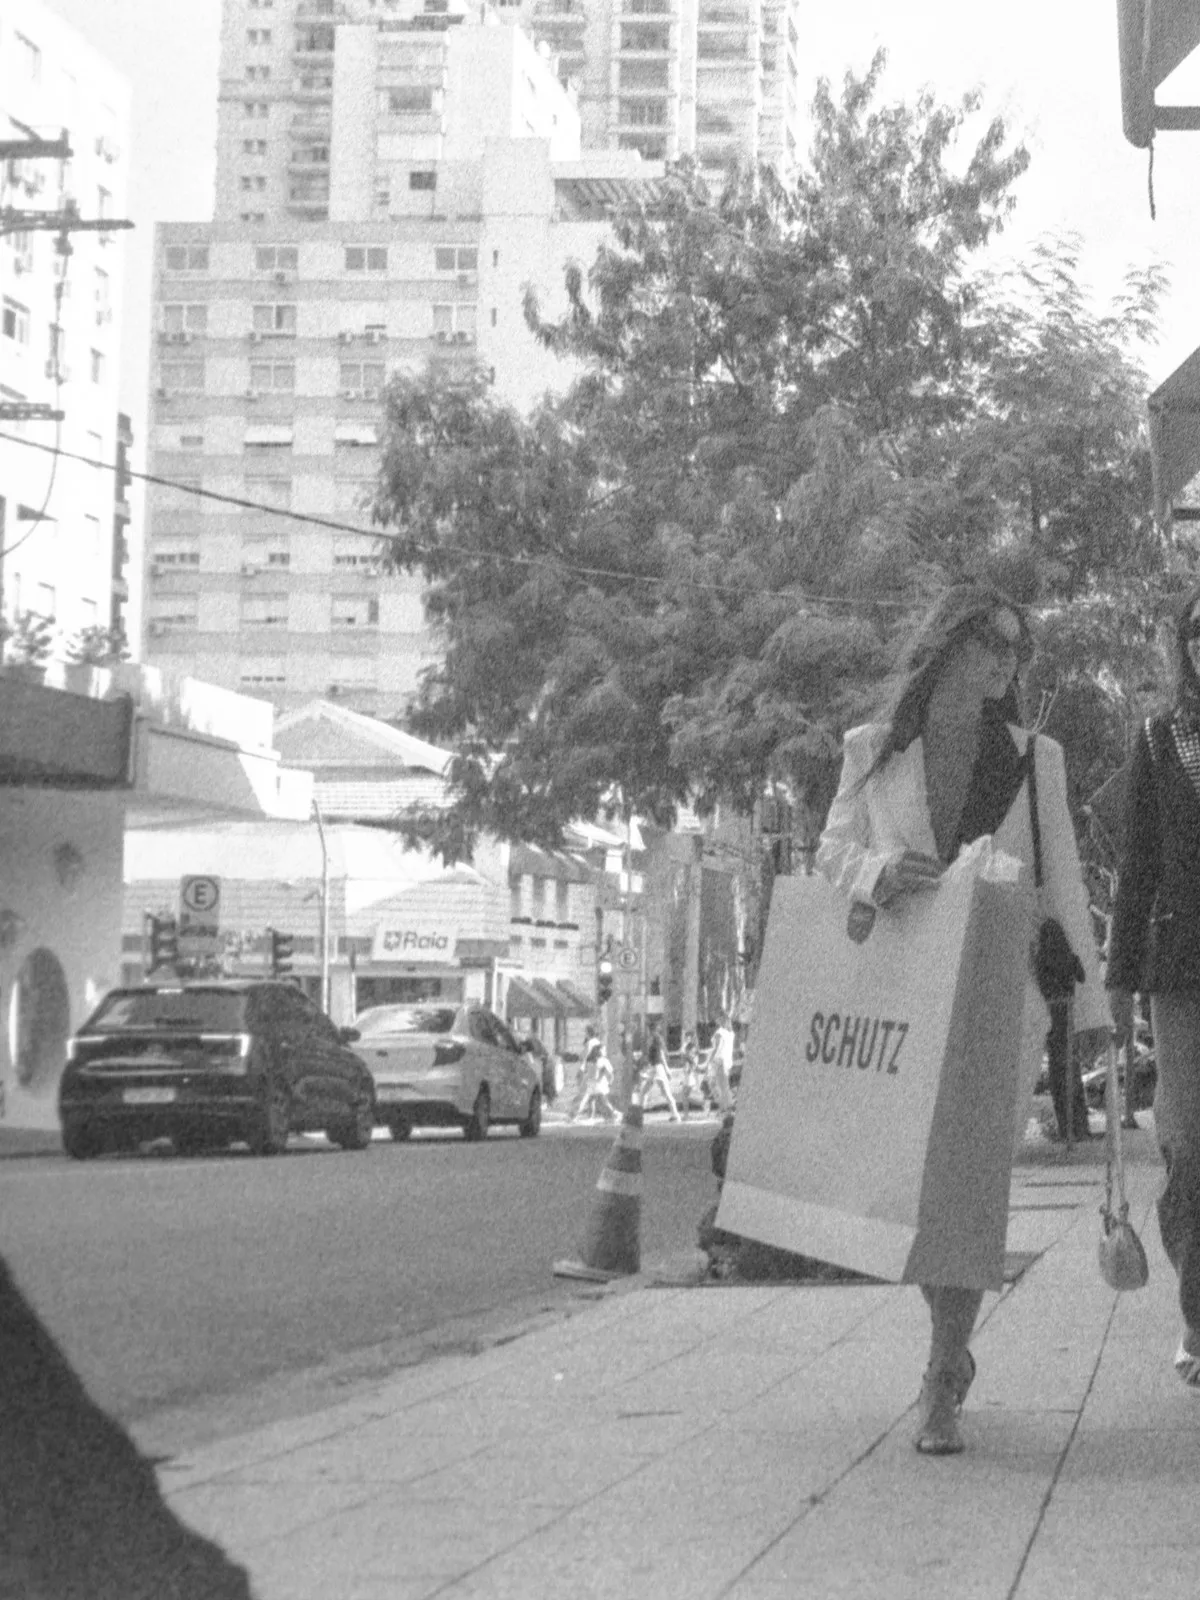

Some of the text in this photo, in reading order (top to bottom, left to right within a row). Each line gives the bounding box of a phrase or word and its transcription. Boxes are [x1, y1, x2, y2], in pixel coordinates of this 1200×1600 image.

[194, 883, 208, 904] E
[403, 930, 448, 950] Raia
[805, 1011, 910, 1075] SCHUTZ
